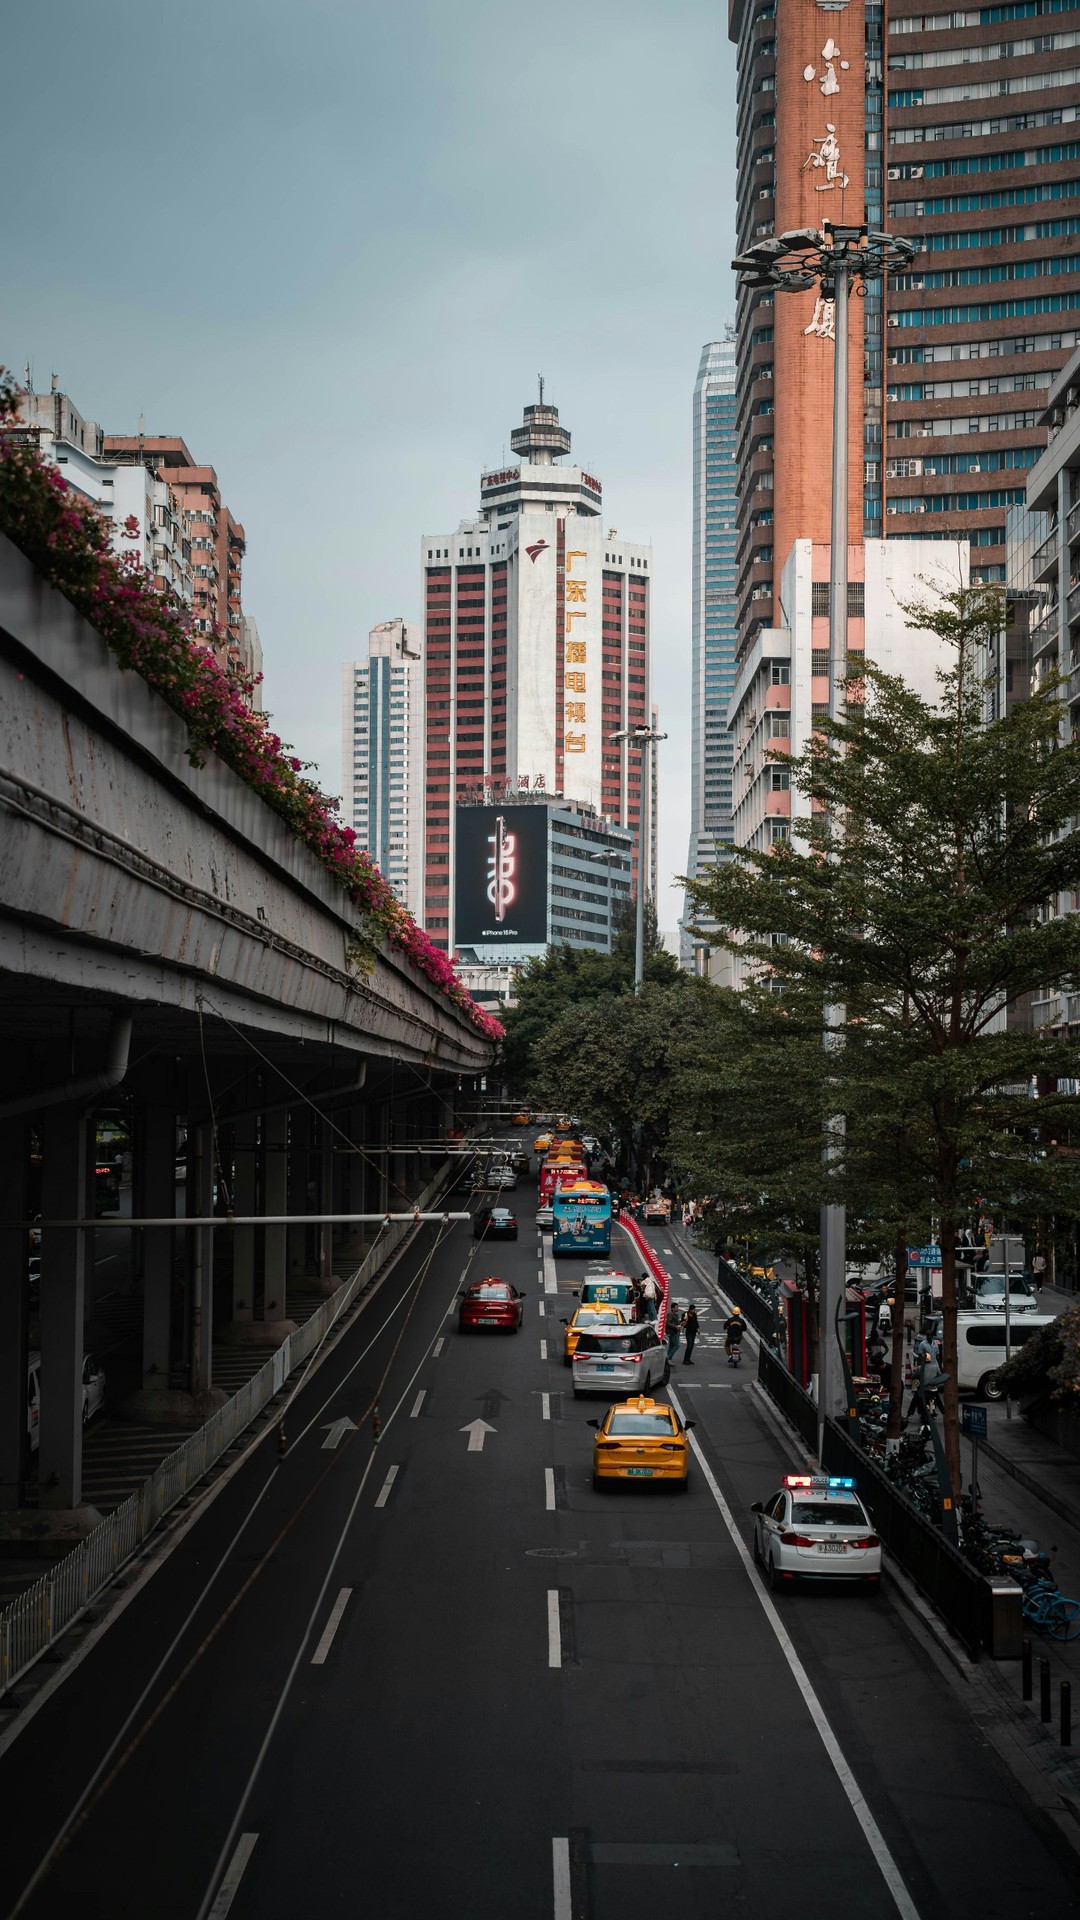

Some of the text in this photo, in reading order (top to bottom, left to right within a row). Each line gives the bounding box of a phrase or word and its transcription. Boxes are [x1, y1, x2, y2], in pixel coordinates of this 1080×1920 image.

[481, 469, 520, 488] 广东电视中心
[565, 551, 587, 753] 广东广播电视台
[487, 835, 515, 905] PRO
